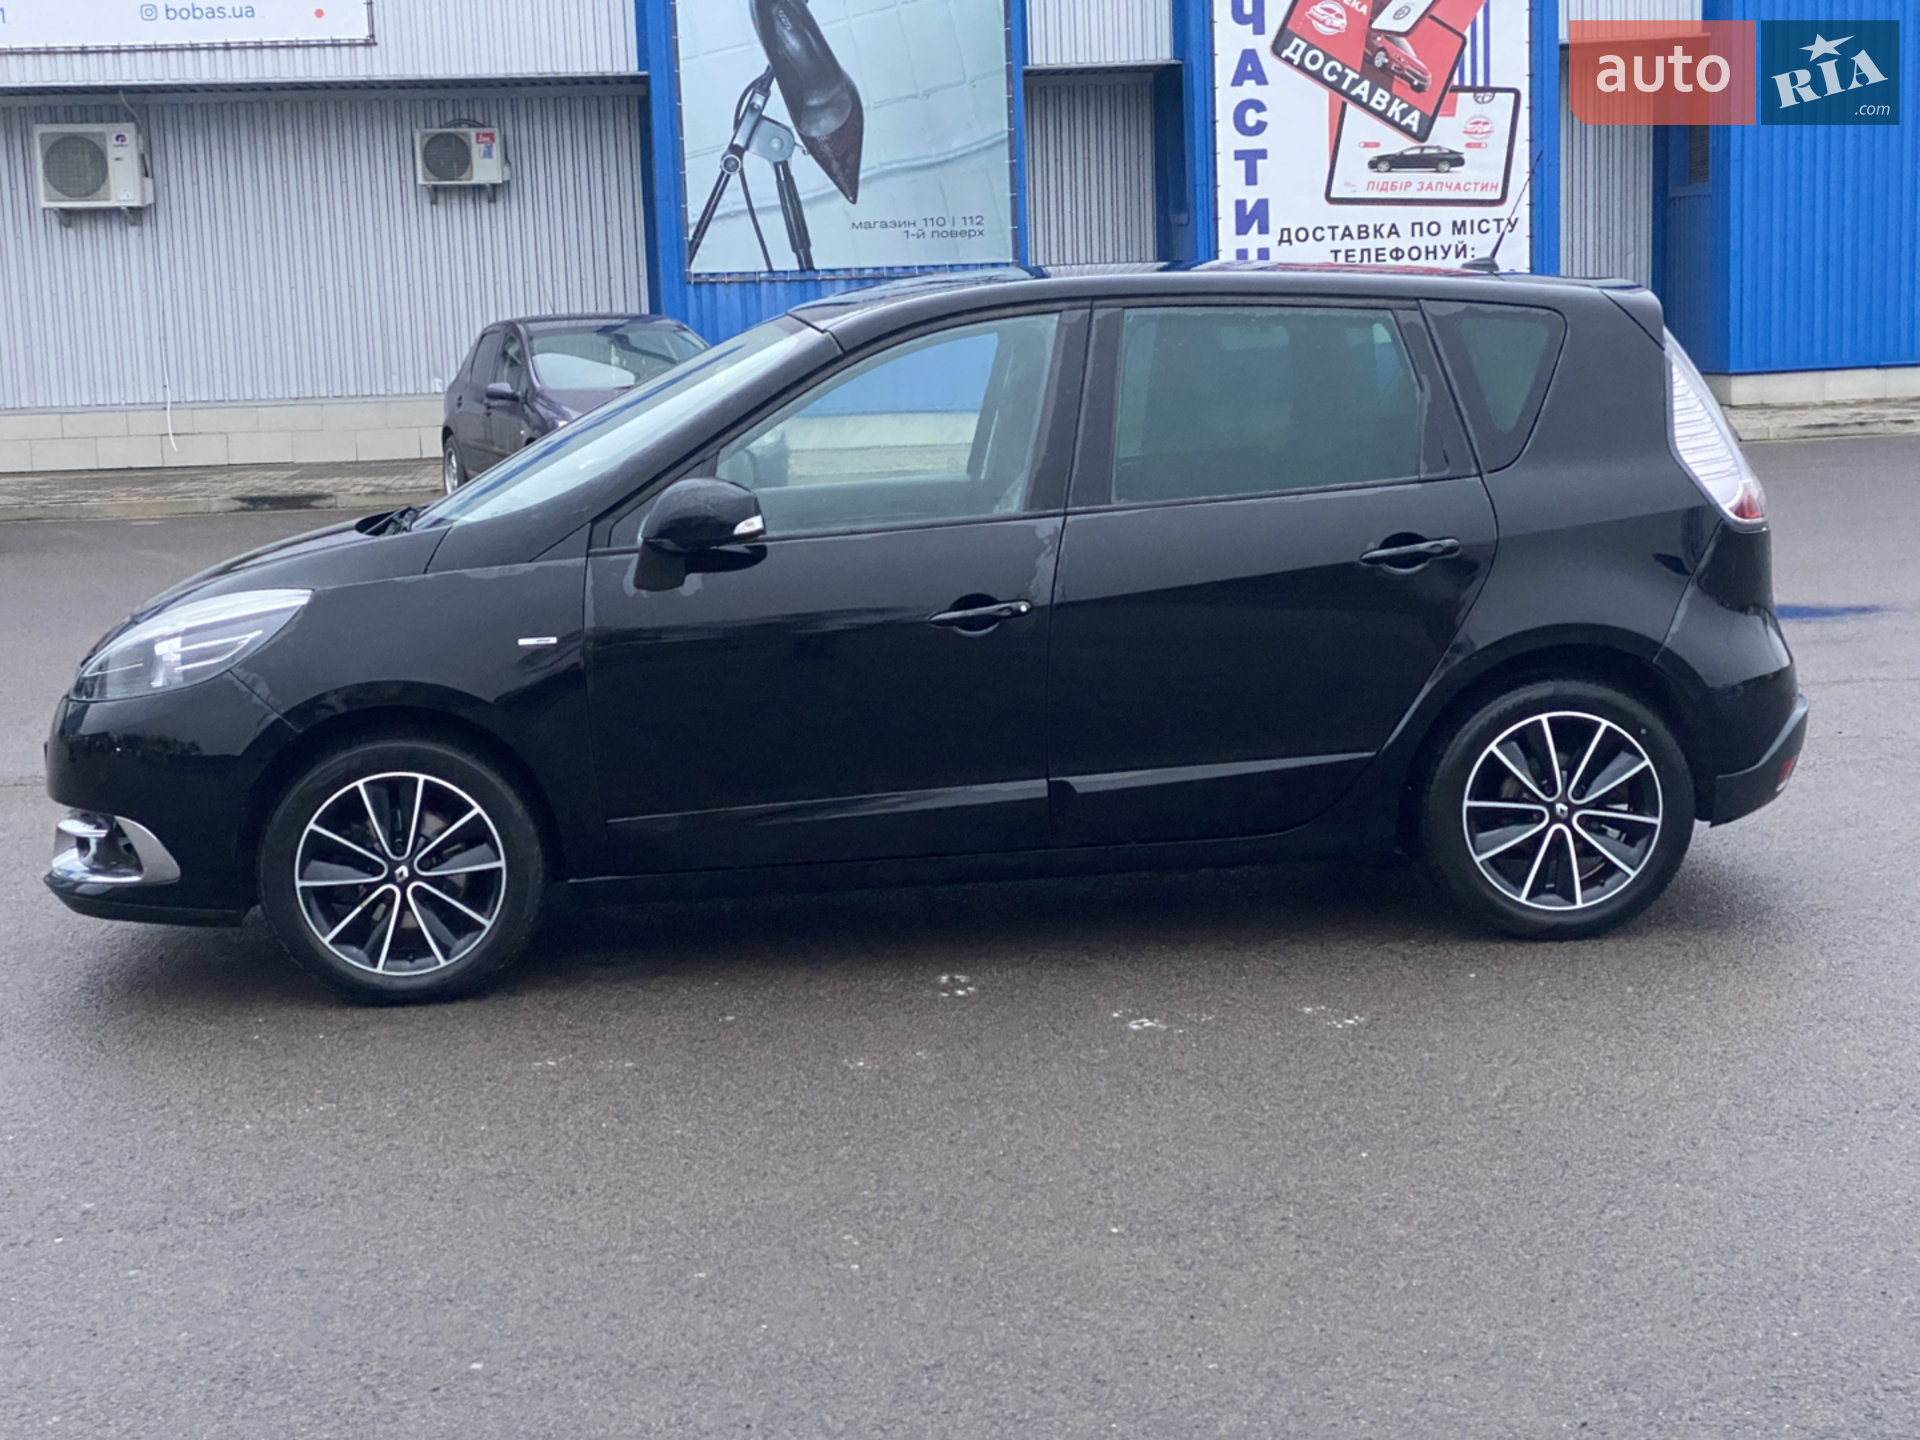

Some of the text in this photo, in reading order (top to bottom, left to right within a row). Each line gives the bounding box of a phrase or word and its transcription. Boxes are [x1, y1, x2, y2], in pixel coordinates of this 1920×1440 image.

[165, 3, 256, 21] bobas.ua
[1281, 36, 1421, 133] ДОСТАВКА
[1366, 181, 1412, 193] ПІДБІР
[1416, 181, 1499, 193] ЗАПЧАСТИН
[851, 219, 917, 230] магазин
[922, 216, 946, 228] 110
[961, 215, 985, 226] 112
[1278, 217, 1518, 246] ДОСТАВКА ПО МІСТУ
[903, 228, 985, 240] 1-й поверх
[1330, 240, 1476, 264] ТЕЛЕФОНУЙ:
